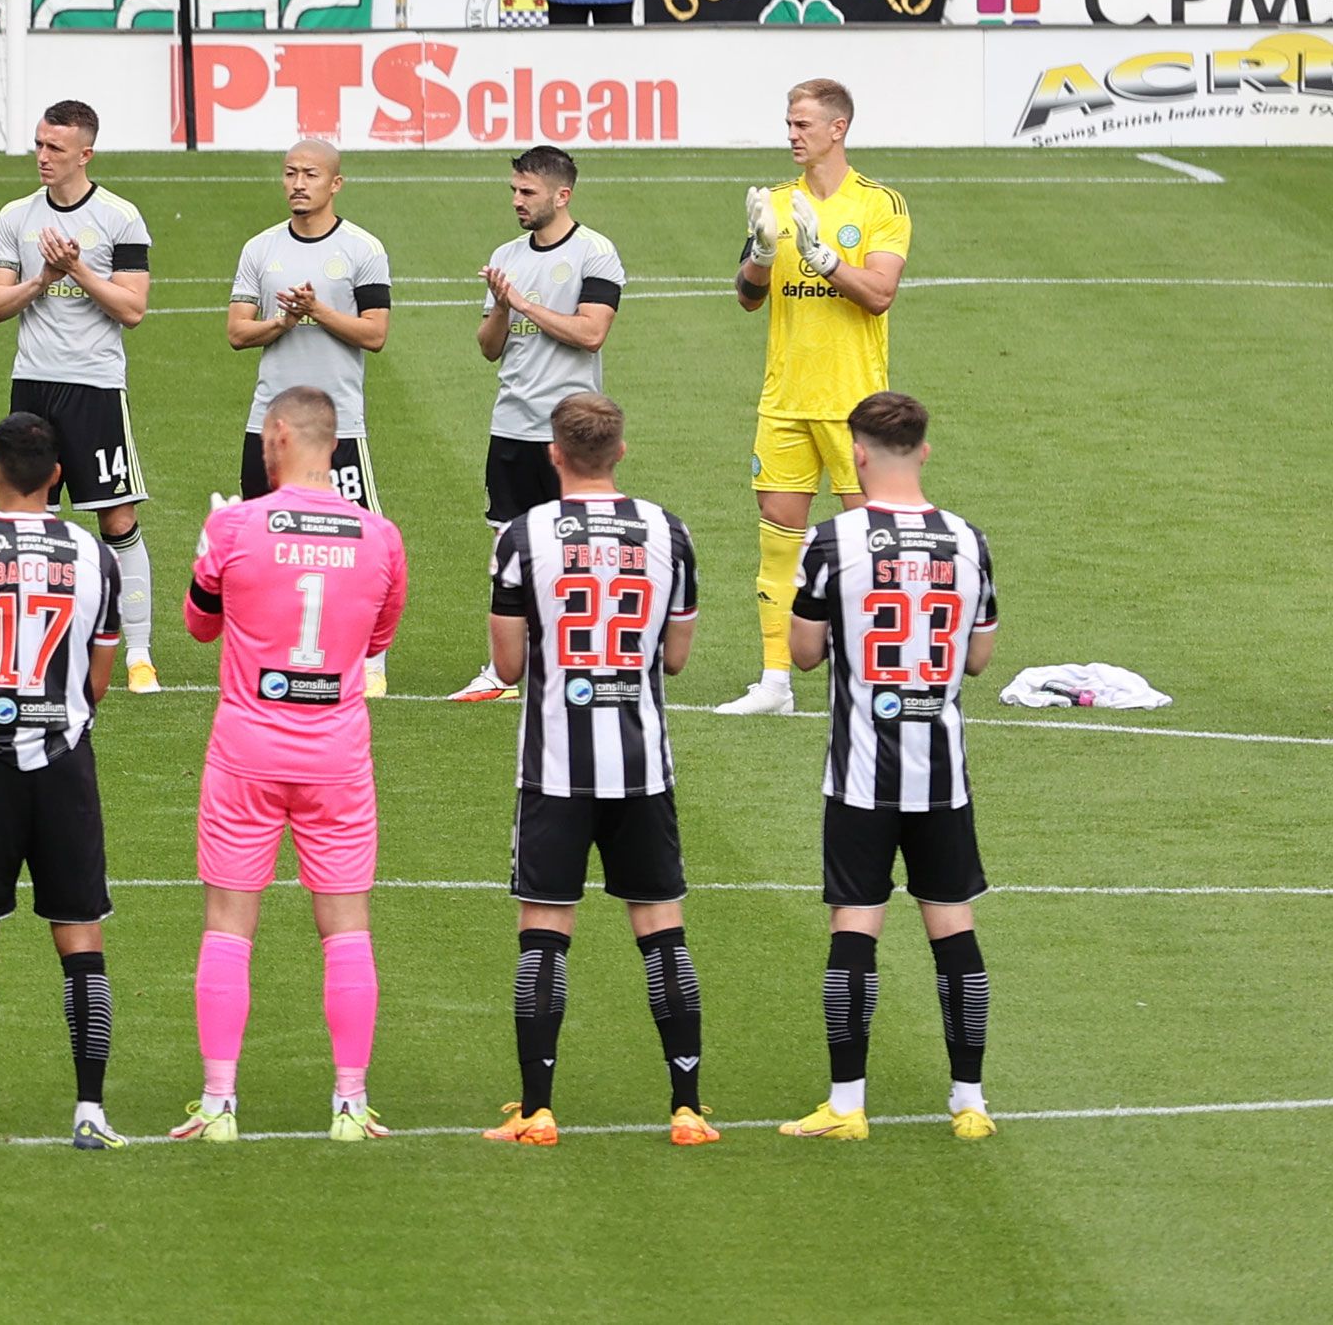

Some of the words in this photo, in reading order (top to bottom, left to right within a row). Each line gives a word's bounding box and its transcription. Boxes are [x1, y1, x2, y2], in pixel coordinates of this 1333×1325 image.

[1031, 125, 1097, 148] Serving
[1102, 112, 1163, 133] British
[1168, 104, 1245, 122] Industry
[1250, 101, 1301, 116] Since
[94, 445, 128, 484] 14
[300, 523, 339, 534] LEASING
[589, 523, 626, 535] LEASING
[16, 536, 41, 547] FIRST
[41, 538, 78, 551] VEHICLE
[16, 544, 55, 554] LEASING
[274, 542, 356, 568] CARSON
[564, 544, 648, 570] FRASER
[876, 559, 954, 585] STRAIN
[288, 571, 326, 669] 1
[553, 573, 656, 669] 22
[861, 589, 964, 685] 23
[291, 678, 340, 692] consilium
[20, 701, 66, 713] consilium
